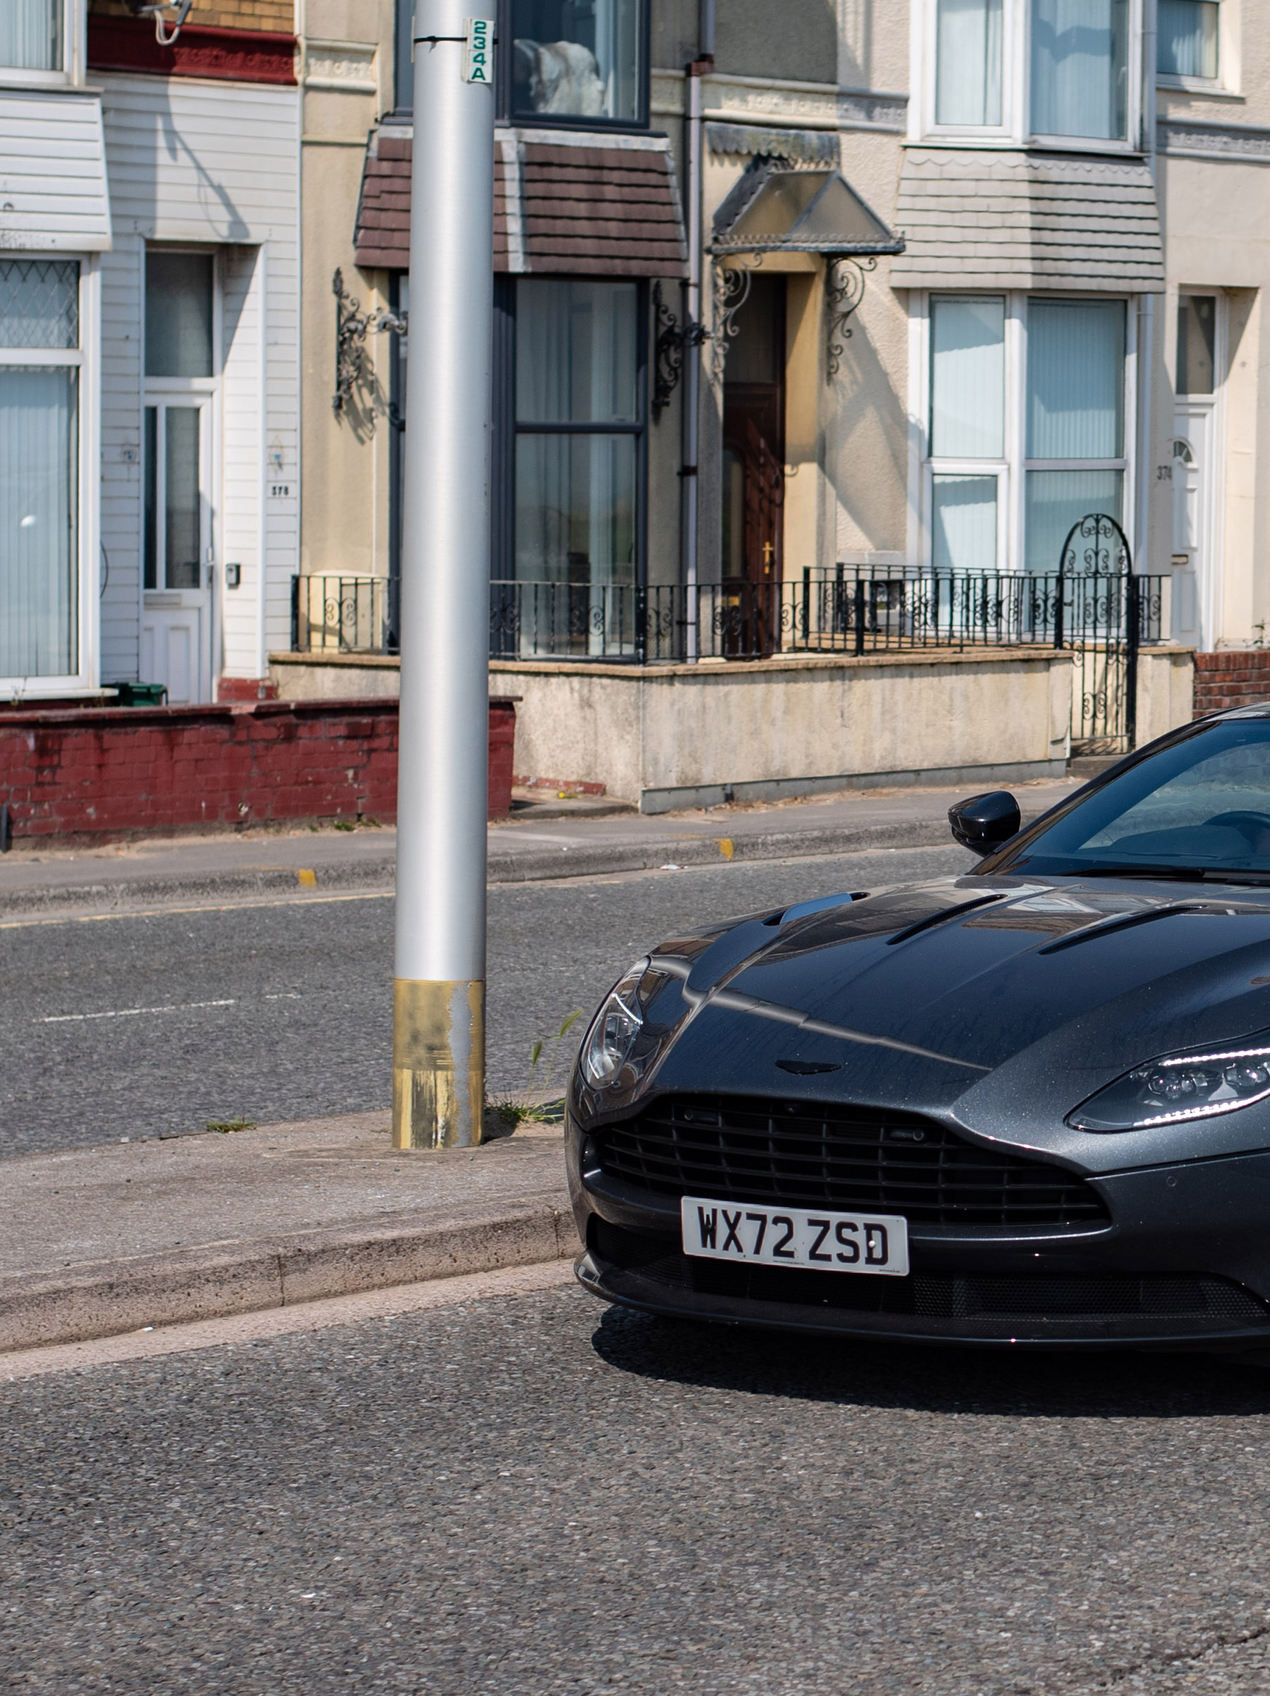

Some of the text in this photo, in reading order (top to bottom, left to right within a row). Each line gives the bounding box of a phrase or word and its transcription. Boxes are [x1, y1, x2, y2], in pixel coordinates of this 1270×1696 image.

[471, 20, 487, 81] 234A
[271, 485, 289, 496] 378
[1157, 465, 1172, 480] 374
[697, 1206, 889, 1266] WX72 ZSD
